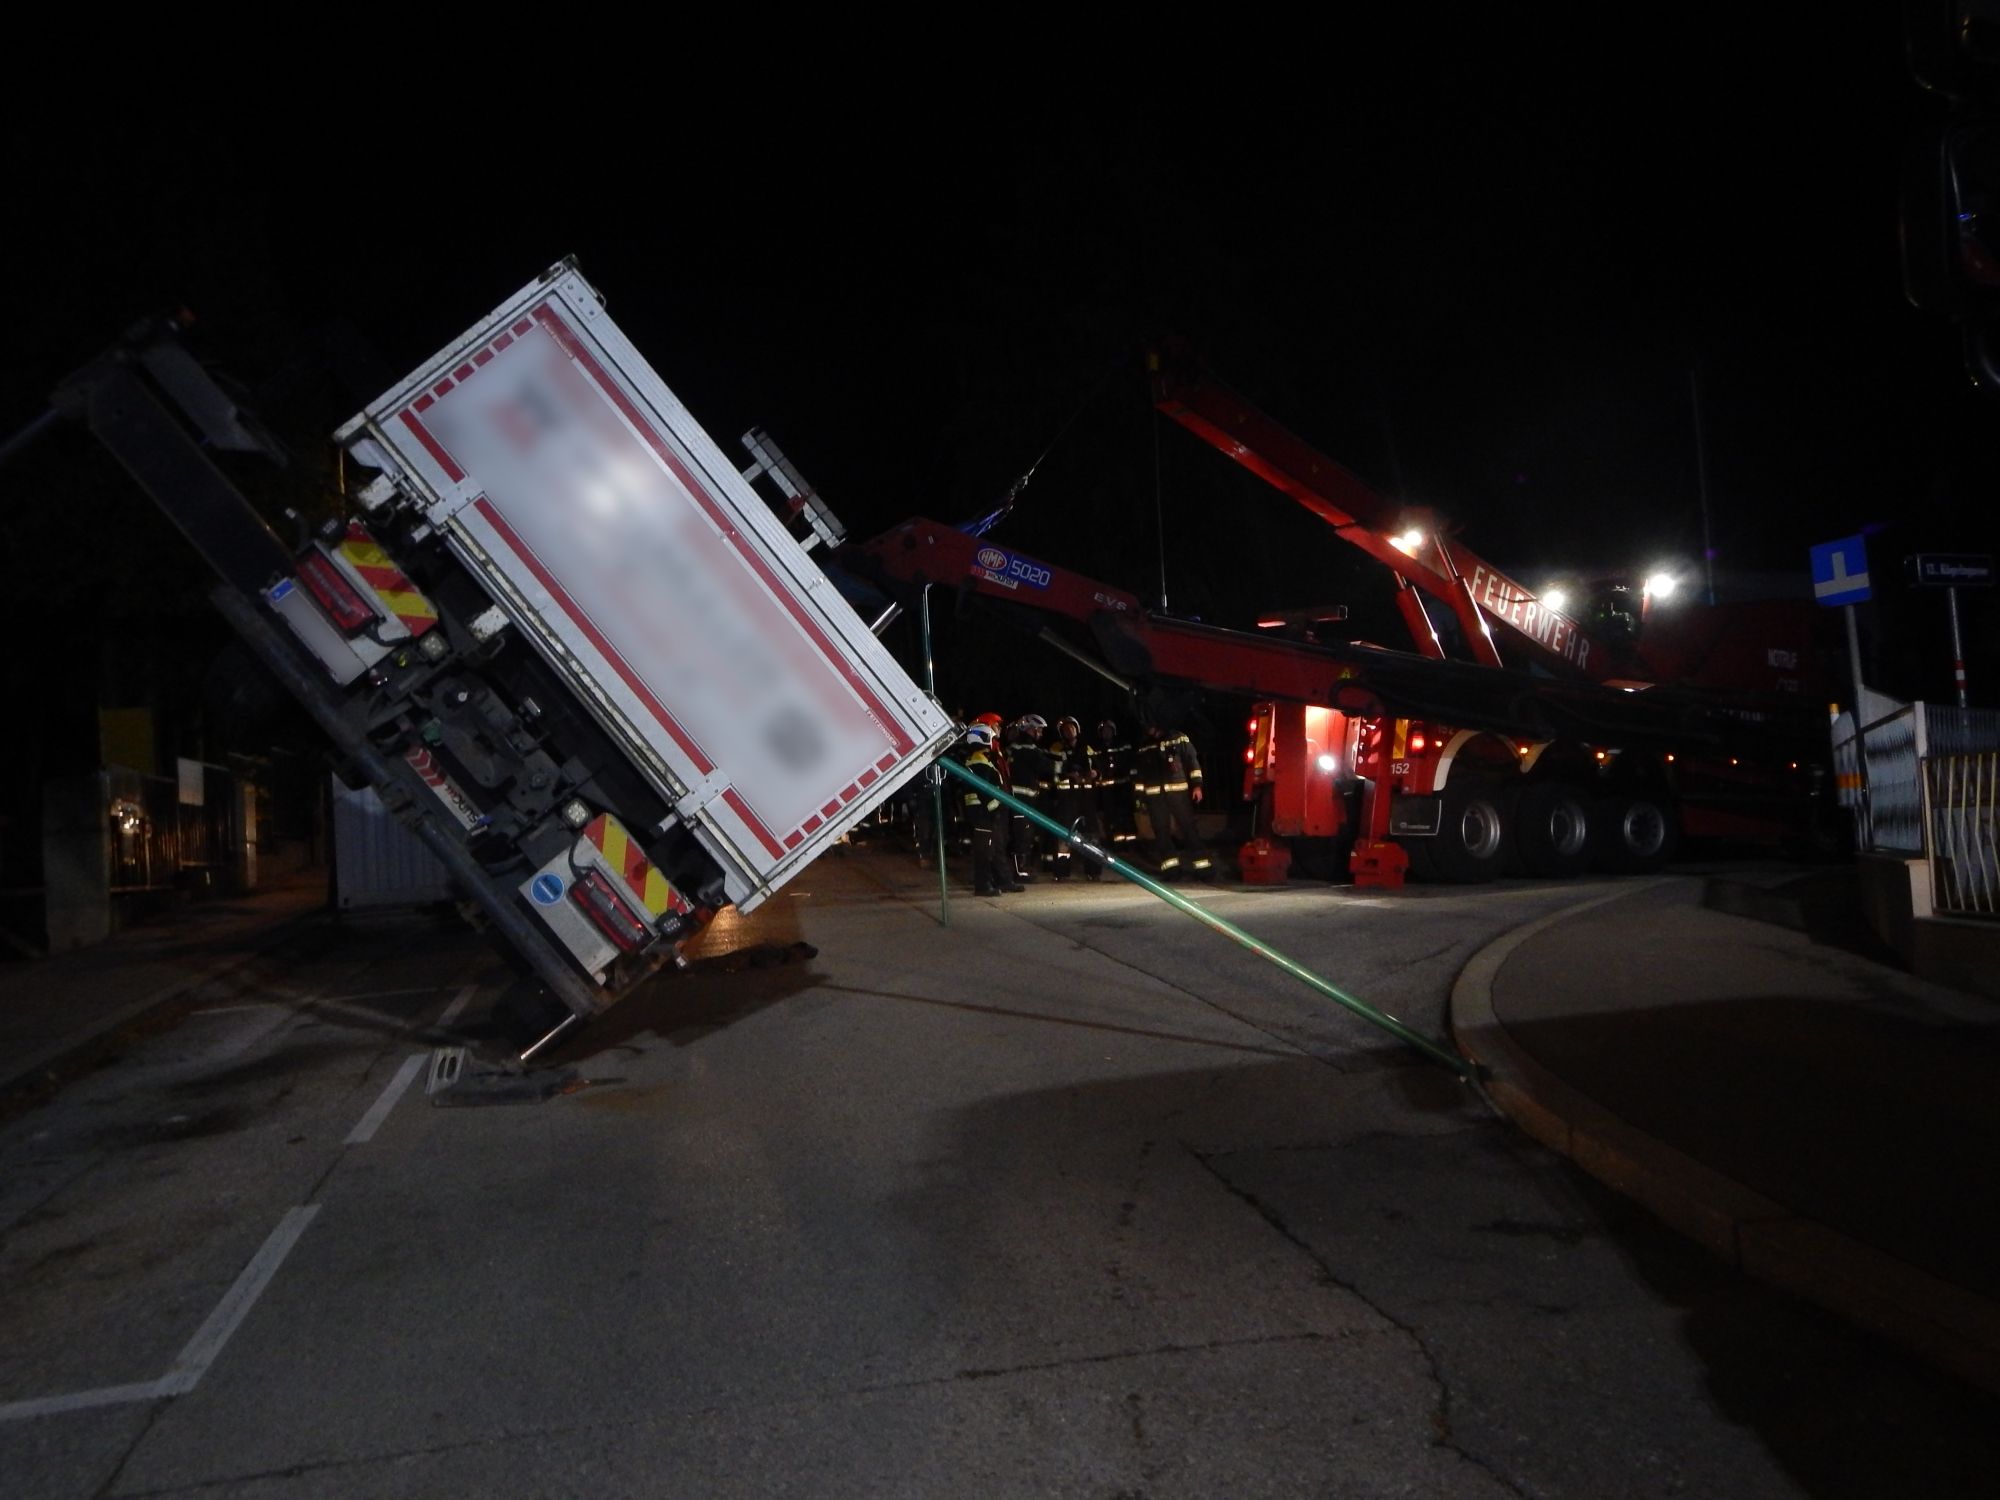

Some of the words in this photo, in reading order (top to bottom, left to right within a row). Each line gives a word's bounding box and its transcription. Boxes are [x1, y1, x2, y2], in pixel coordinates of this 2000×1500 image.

[980, 550, 1004, 568] HMF
[1010, 559, 1051, 587] 5020
[1471, 565, 1590, 670] FEUERWEHR
[1390, 763, 1410, 775] 152
